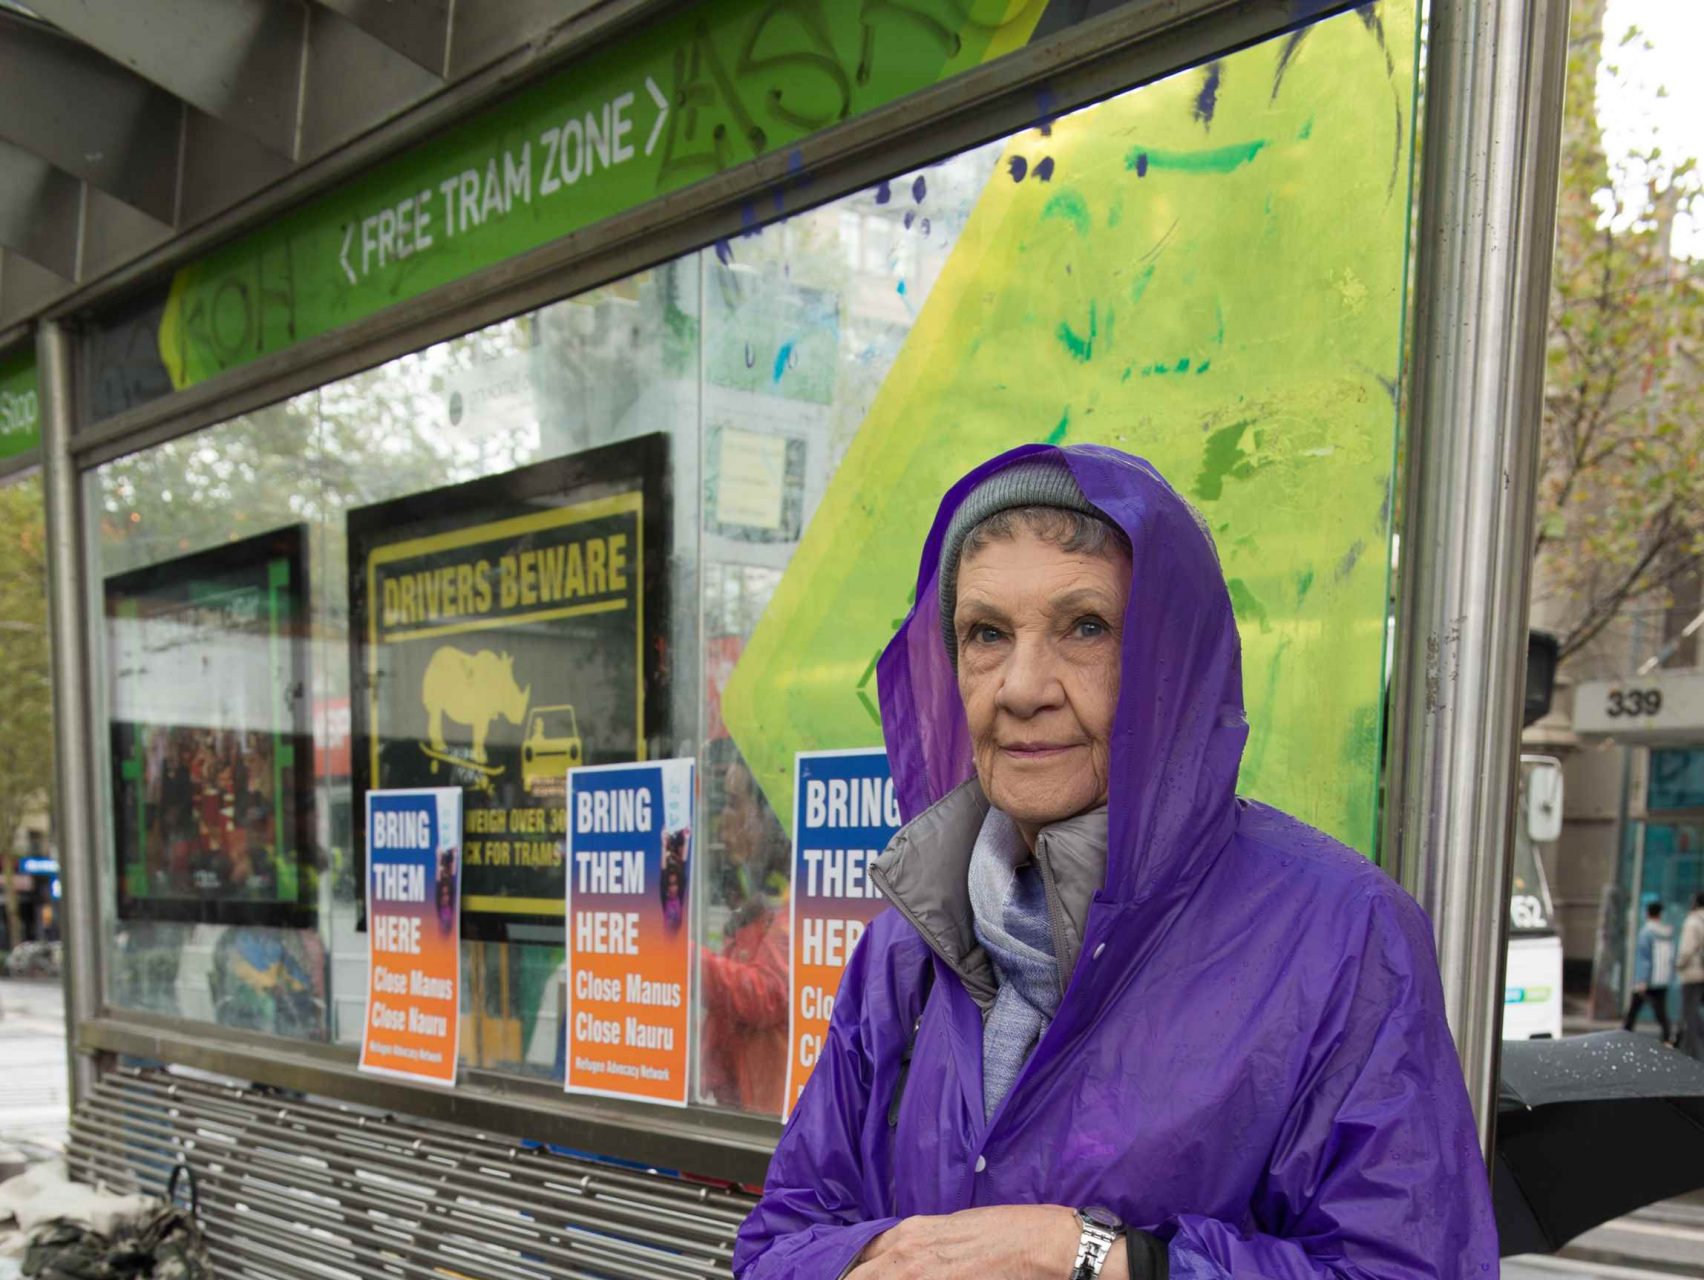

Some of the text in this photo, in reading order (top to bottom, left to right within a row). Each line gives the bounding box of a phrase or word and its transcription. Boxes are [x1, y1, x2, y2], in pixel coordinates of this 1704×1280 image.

[361, 91, 635, 275] FREE TRAM ZONE
[383, 534, 627, 627] DRIVERS BEWARE
[1606, 689, 1663, 718] 339
[509, 808, 545, 833] OVER
[576, 788, 651, 833] BRING
[805, 777, 902, 828] BRING
[374, 811, 430, 849] BRING
[485, 841, 510, 866] FOR
[514, 841, 561, 867] TRAMS
[576, 851, 645, 894] THEM
[373, 863, 425, 902] THEM
[374, 915, 421, 954] HERE
[576, 911, 640, 955] HERE
[374, 966, 453, 1000] Close Manus
[576, 970, 681, 1008] Close Manus
[372, 1002, 447, 1037] Close Nauru
[575, 1011, 674, 1050] Close Nauru
